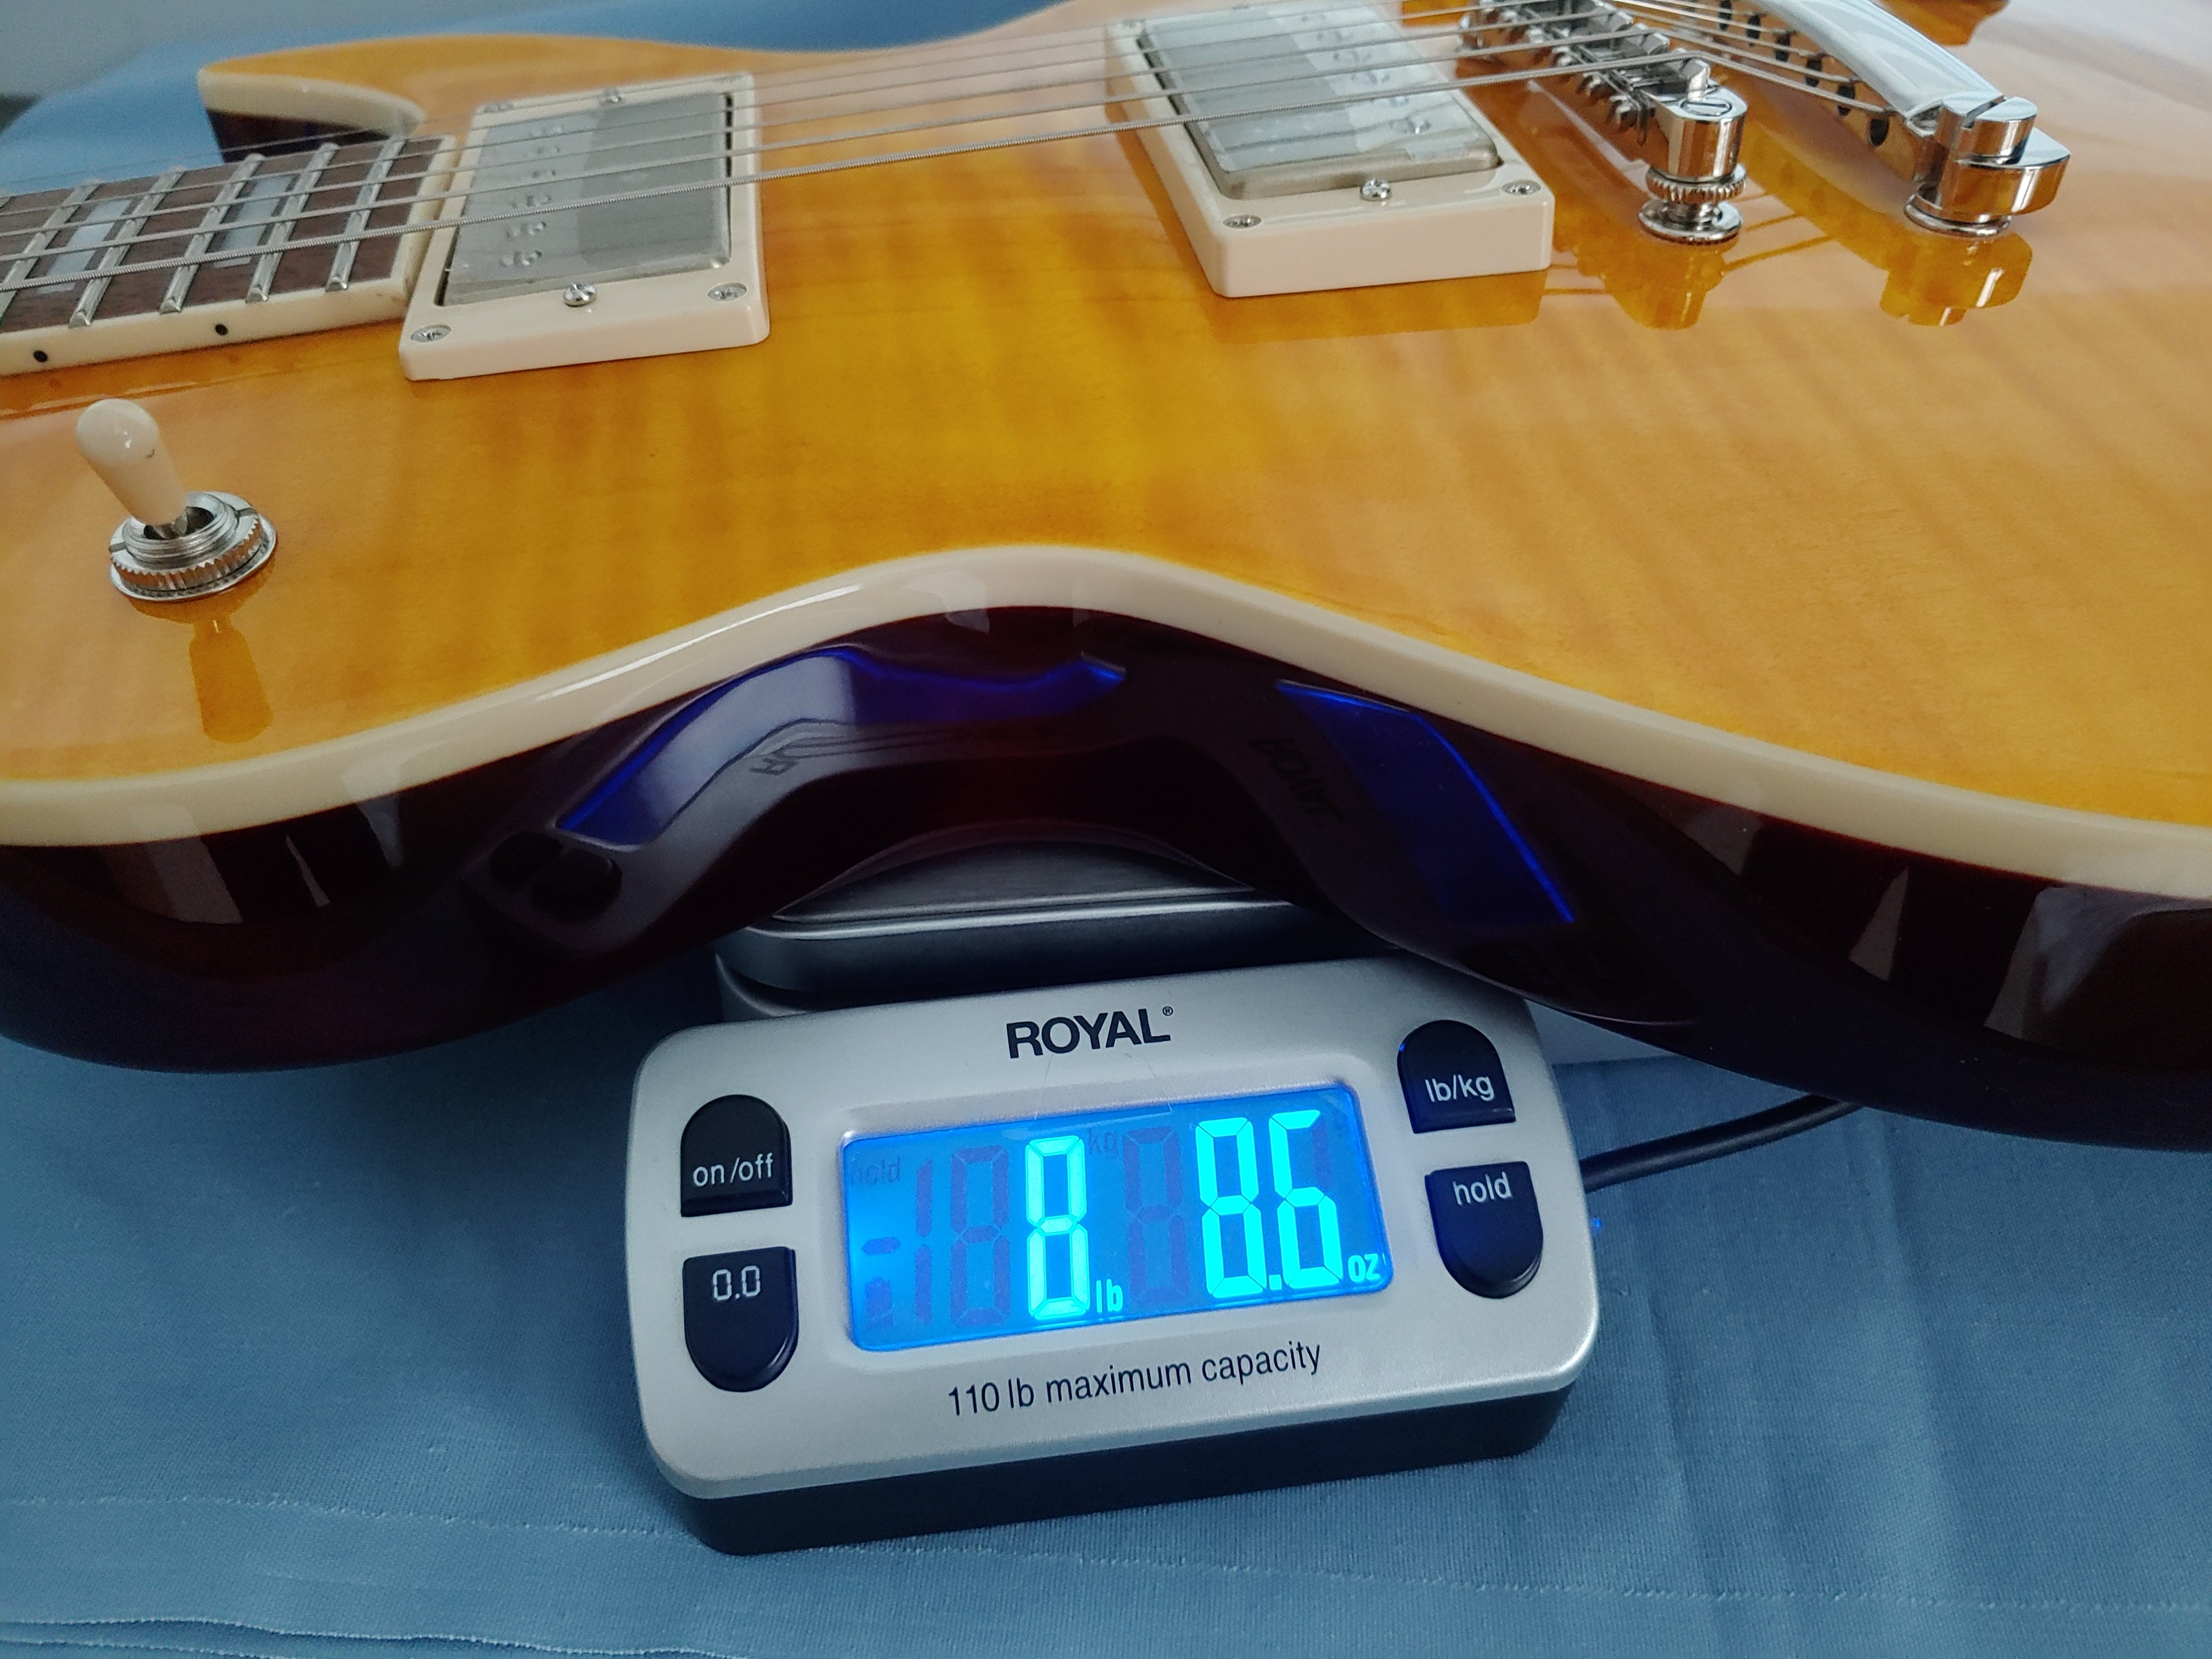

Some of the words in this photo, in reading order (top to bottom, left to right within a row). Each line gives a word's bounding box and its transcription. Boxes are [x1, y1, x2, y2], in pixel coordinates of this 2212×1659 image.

[1425, 1074, 1494, 1102] lb/kg
[693, 1152, 774, 1187] on/off
[1452, 1171, 1513, 1206] hold
[1024, 1135, 1091, 1319] 8
[1097, 1281, 1123, 1314] lb
[1195, 1109, 1343, 1299] 8.6
[1348, 1253, 1381, 1284] oz
[713, 1266, 761, 1301] 0.0
[948, 1381, 1000, 1416] 110
[1007, 1377, 1035, 1409] lb
[1046, 1362, 1192, 1403] maximum
[1201, 1340, 1320, 1385] capacity
